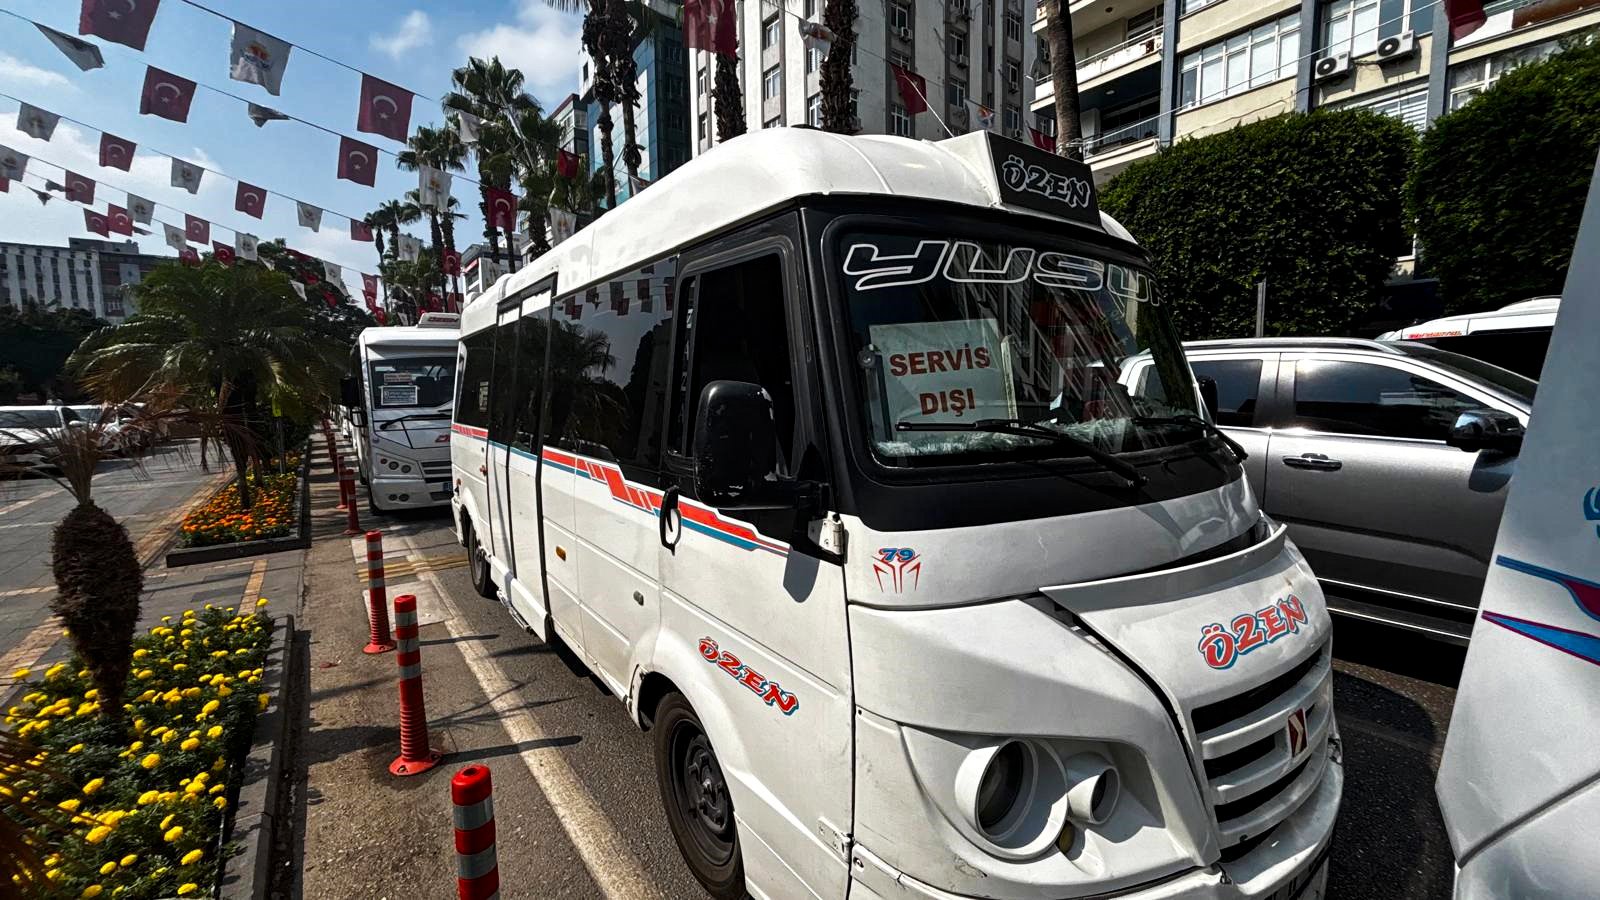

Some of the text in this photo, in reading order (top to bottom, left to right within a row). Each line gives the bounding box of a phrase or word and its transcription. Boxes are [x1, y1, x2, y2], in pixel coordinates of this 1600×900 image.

[1002, 154, 1091, 208] ÖZEN
[889, 343, 991, 377] SERVİS
[919, 388, 976, 417] DIŞI
[879, 547, 916, 562] 79
[1199, 594, 1308, 669] ÖZEN
[698, 636, 800, 716] ÖZEN
